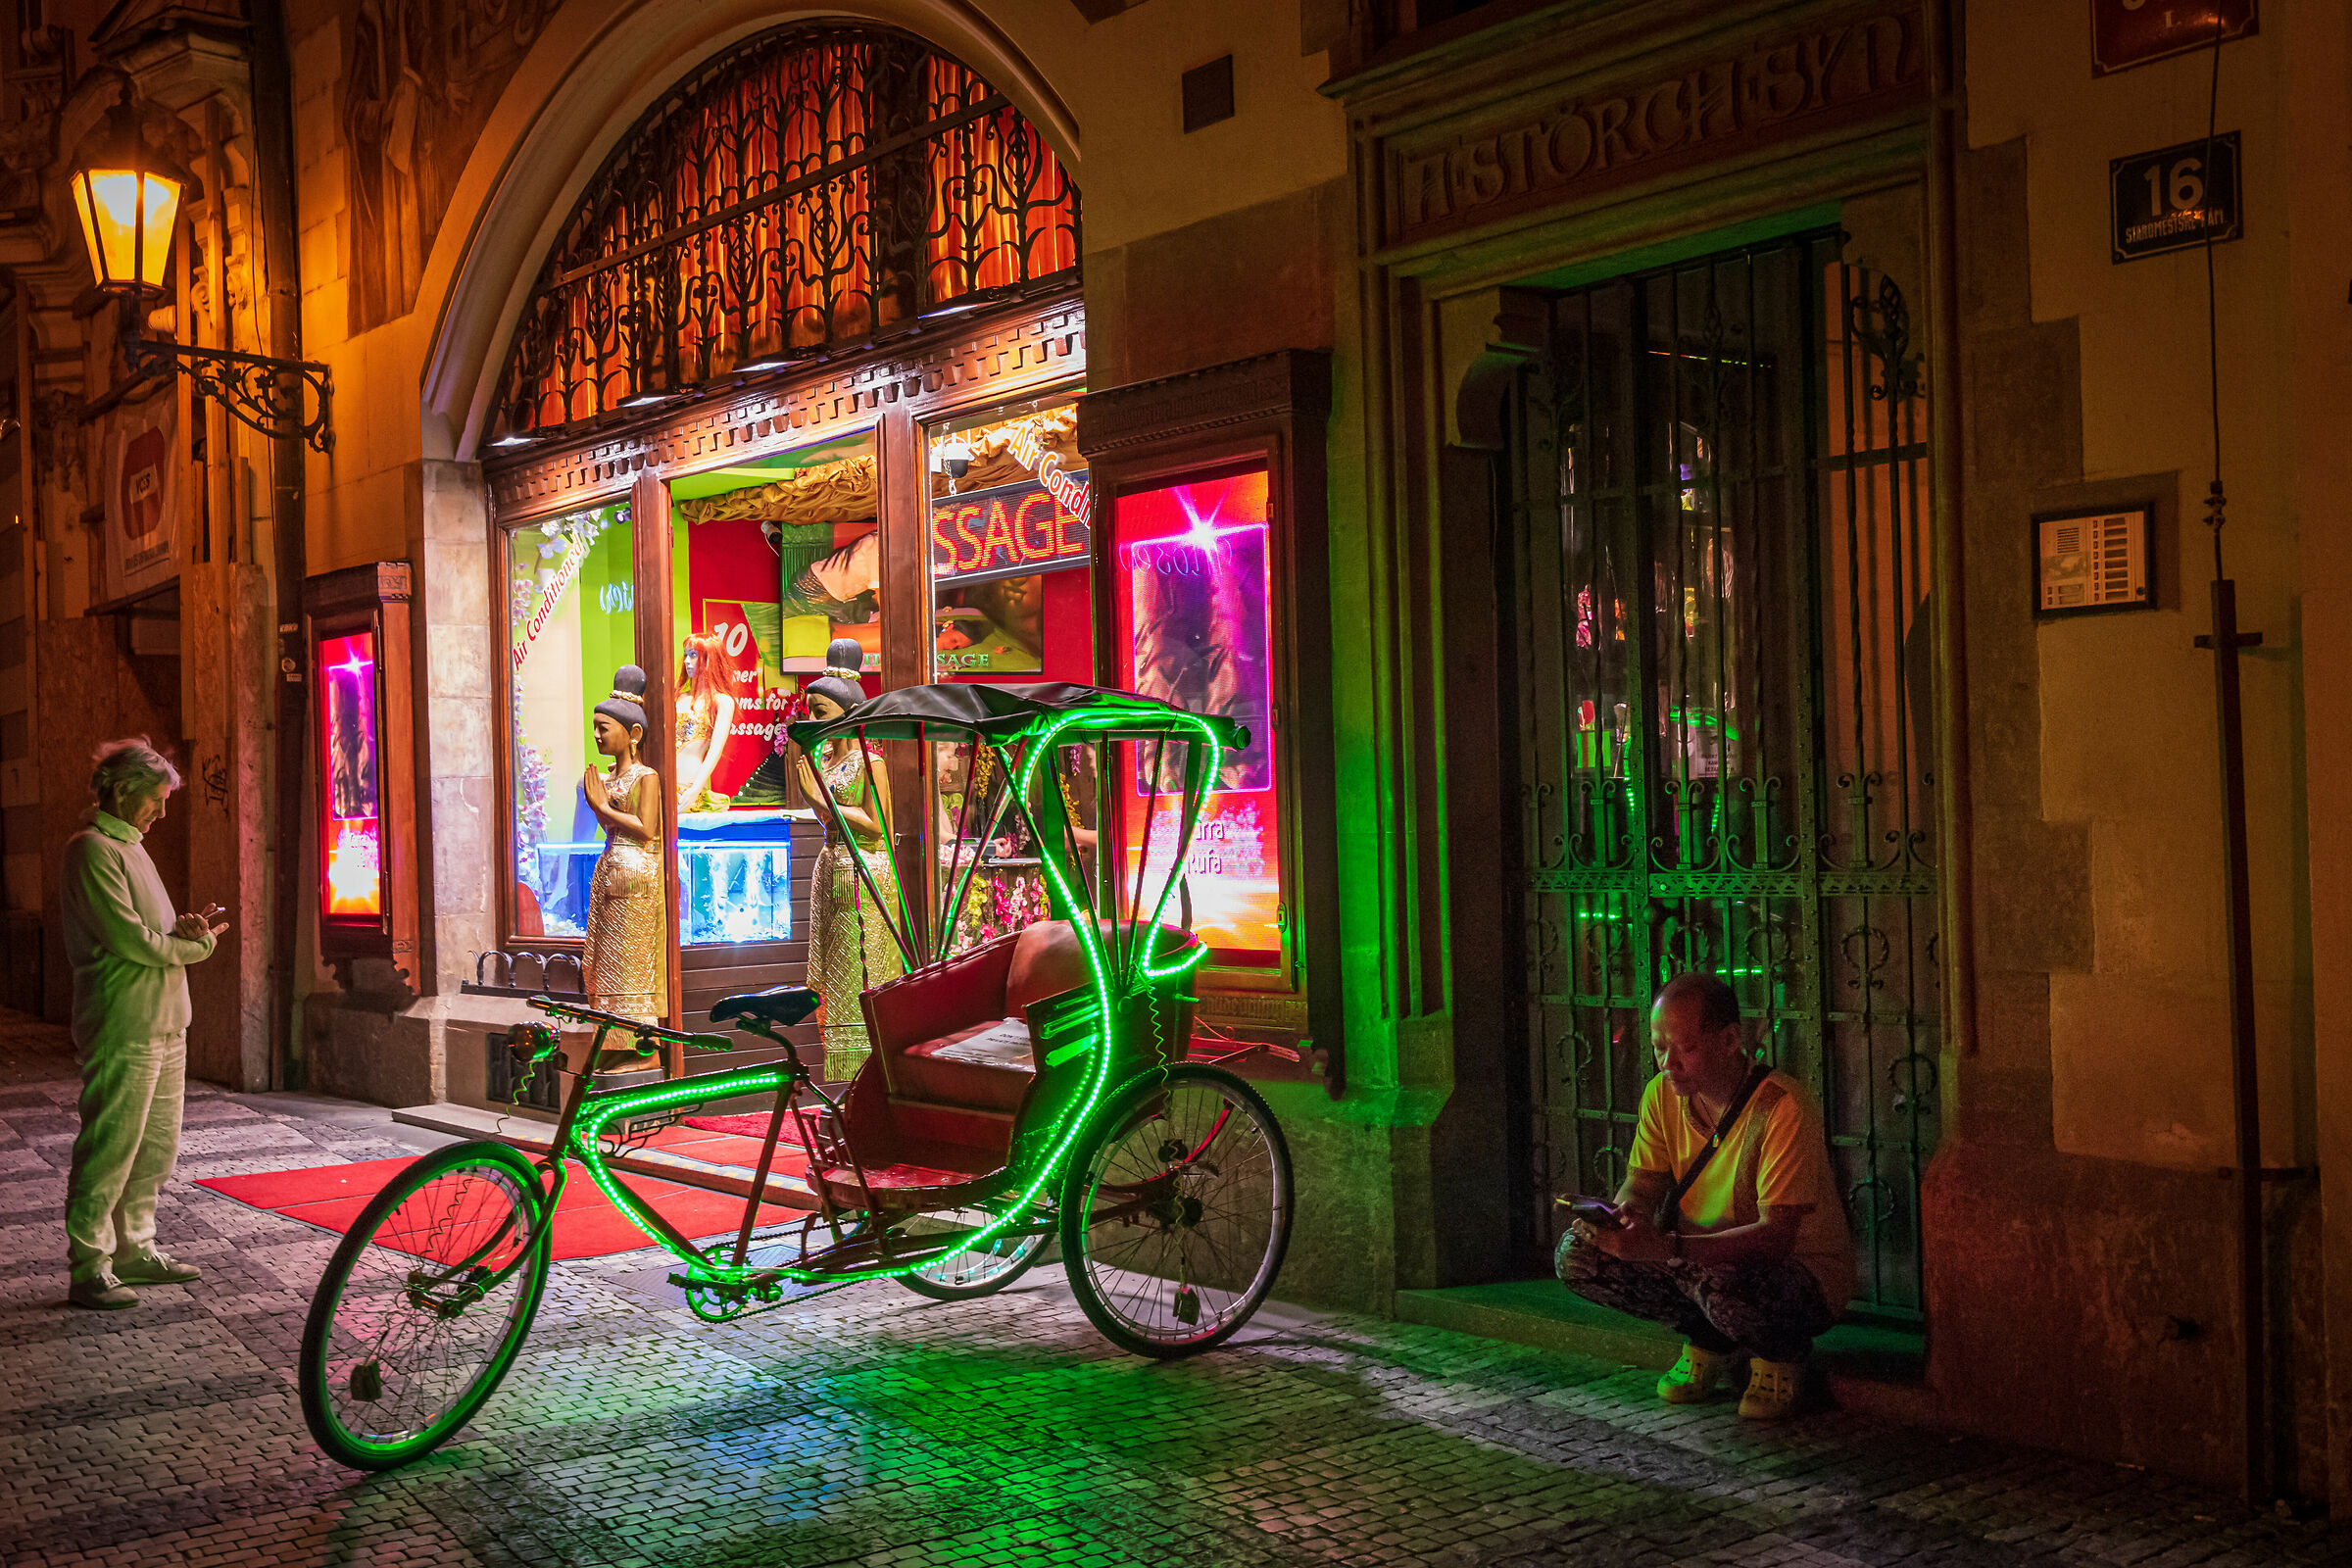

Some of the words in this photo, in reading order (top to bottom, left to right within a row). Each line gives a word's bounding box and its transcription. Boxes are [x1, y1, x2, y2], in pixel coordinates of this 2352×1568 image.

[2143, 158, 2204, 217] 16
[1007, 424, 1041, 470] Air
[1039, 451, 1090, 529] Condi
[511, 639, 529, 671] Air
[525, 533, 584, 643] Conditioned
[713, 621, 749, 658] 10
[937, 653, 990, 667] SAGE
[736, 697, 761, 710] ms
[765, 693, 788, 711] for
[729, 722, 782, 742] assage
